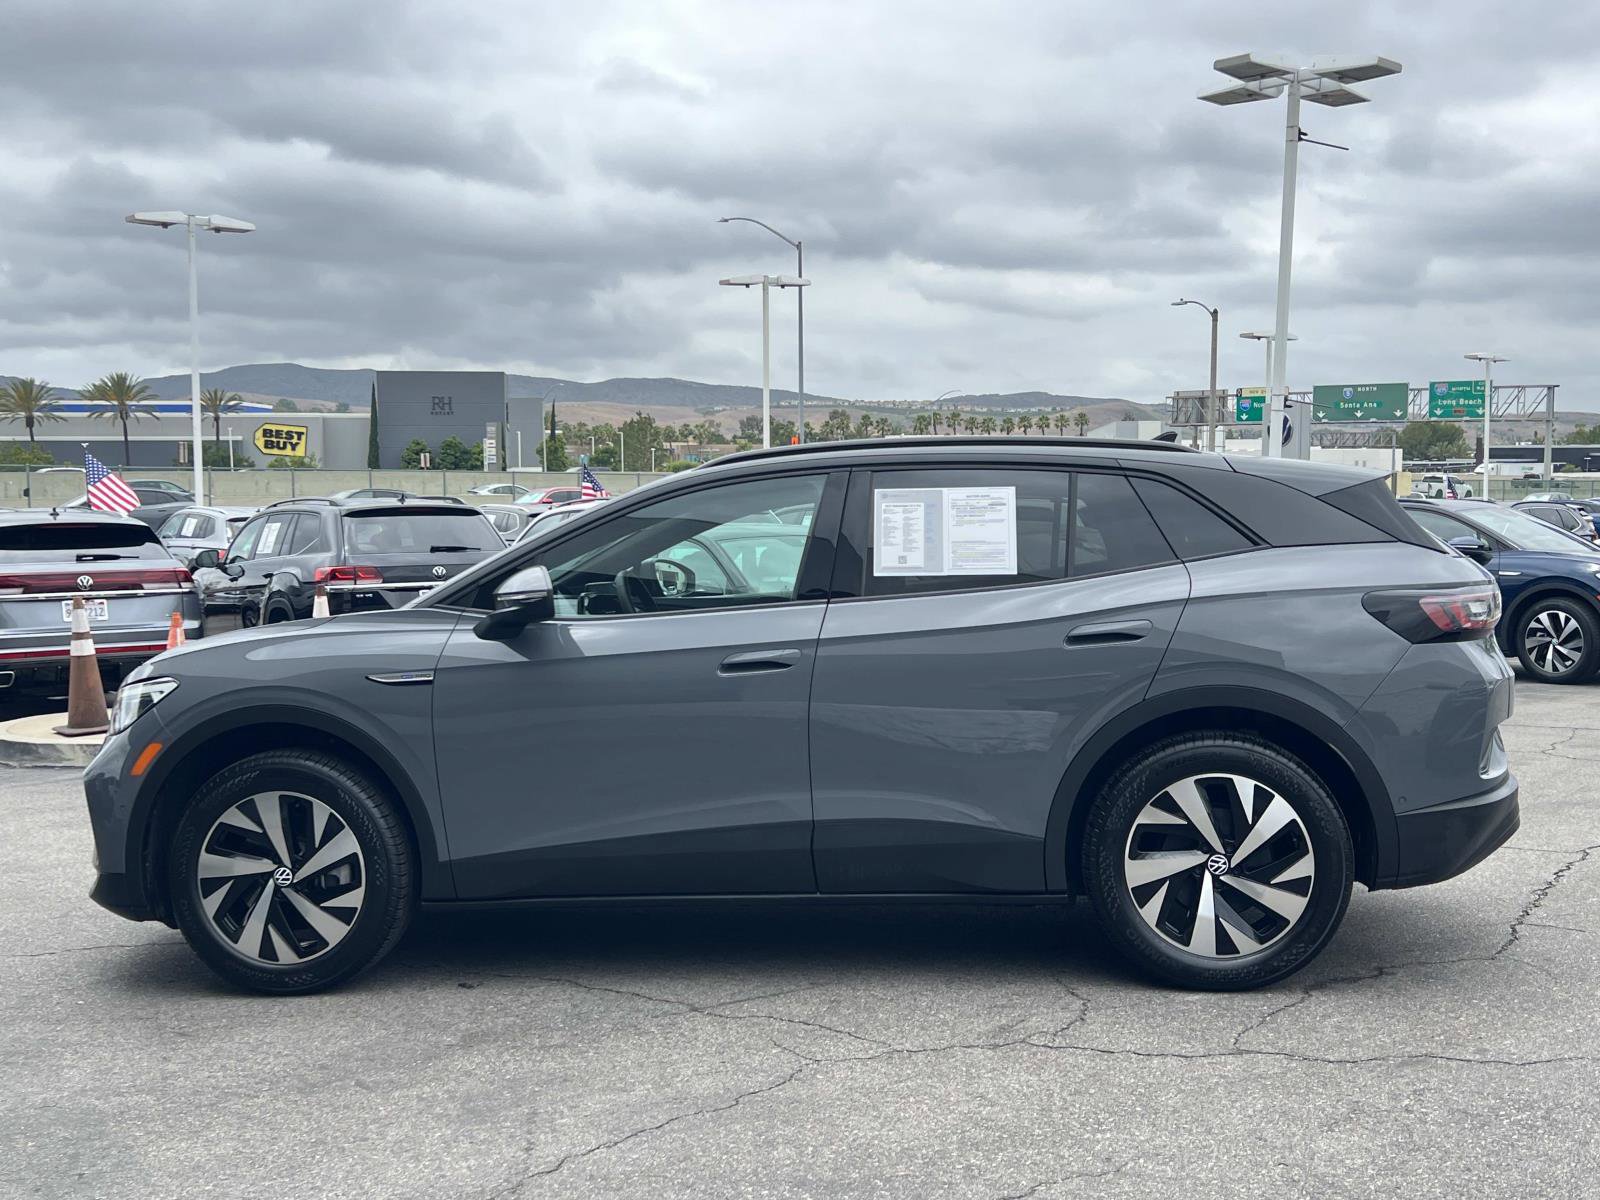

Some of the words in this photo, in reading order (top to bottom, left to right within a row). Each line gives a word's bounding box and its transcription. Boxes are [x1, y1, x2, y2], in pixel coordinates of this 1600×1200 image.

[431, 396, 453, 411] RH
[263, 428, 304, 441] BEST
[264, 440, 301, 451] BUY
